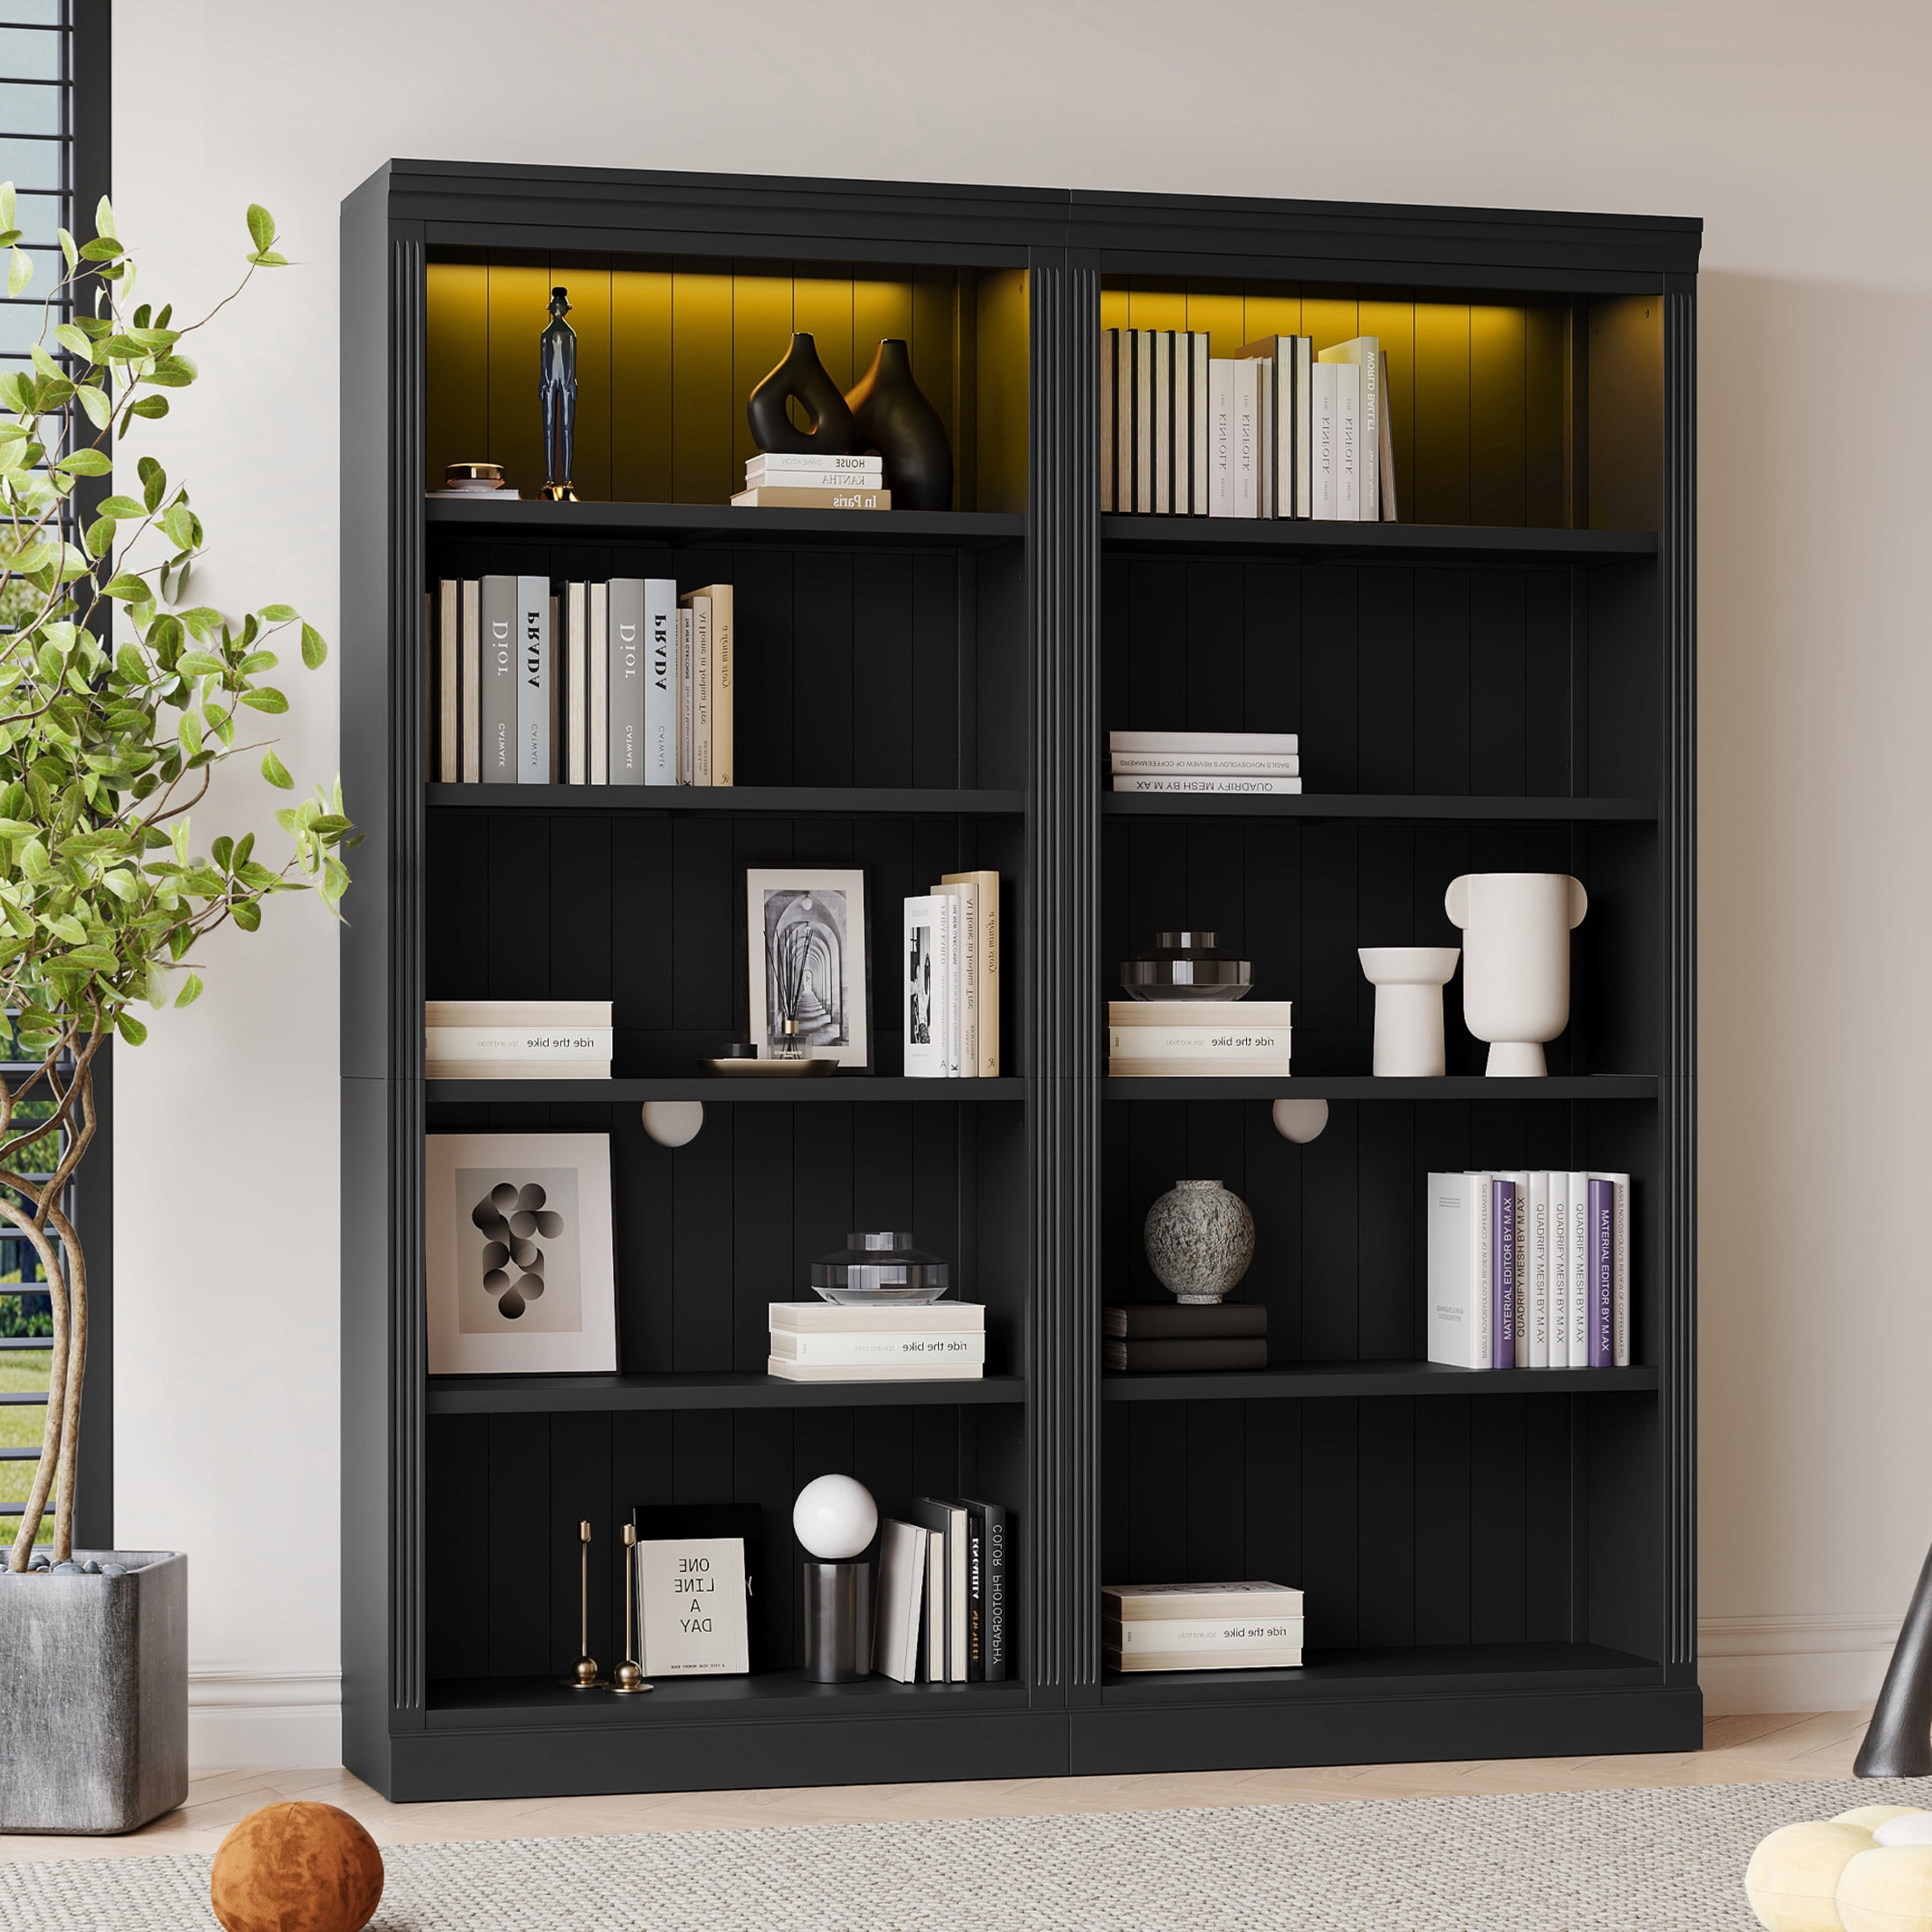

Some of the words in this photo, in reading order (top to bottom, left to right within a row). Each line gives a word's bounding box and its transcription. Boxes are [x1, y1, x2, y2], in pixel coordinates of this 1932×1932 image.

[1136, 781, 1163, 789] M.AX
[1166, 782, 1180, 790] BY
[1184, 782, 1215, 790] MESH
[1217, 782, 1273, 791] QUADRIFY
[1503, 1198, 1512, 1225] M.AX
[1517, 1197, 1525, 1225] M.AX
[1503, 1226, 1512, 1241] BY
[1517, 1227, 1525, 1243] BY
[1536, 1203, 1545, 1261] QUADRIFY
[1575, 1203, 1584, 1260] QUADRIFY
[1601, 1209, 1610, 1262] MATERIAL
[1481, 1241, 1488, 1251] OF
[1503, 1244, 1512, 1285] EDITOR
[1517, 1245, 1525, 1278] MESH
[1536, 1264, 1545, 1296] MESH
[1575, 1264, 1584, 1295] MESH
[1601, 1265, 1610, 1306] EDITOR
[1517, 1280, 1525, 1337] QUADRIFY
[1536, 1299, 1545, 1314] BY
[1556, 1299, 1564, 1314] BY
[1575, 1299, 1584, 1314] BY
[1618, 1292, 1625, 1301] OF
[1503, 1287, 1512, 1340] MATERIAL
[1601, 1308, 1610, 1323] BY
[1601, 1324, 1610, 1352] M.AX
